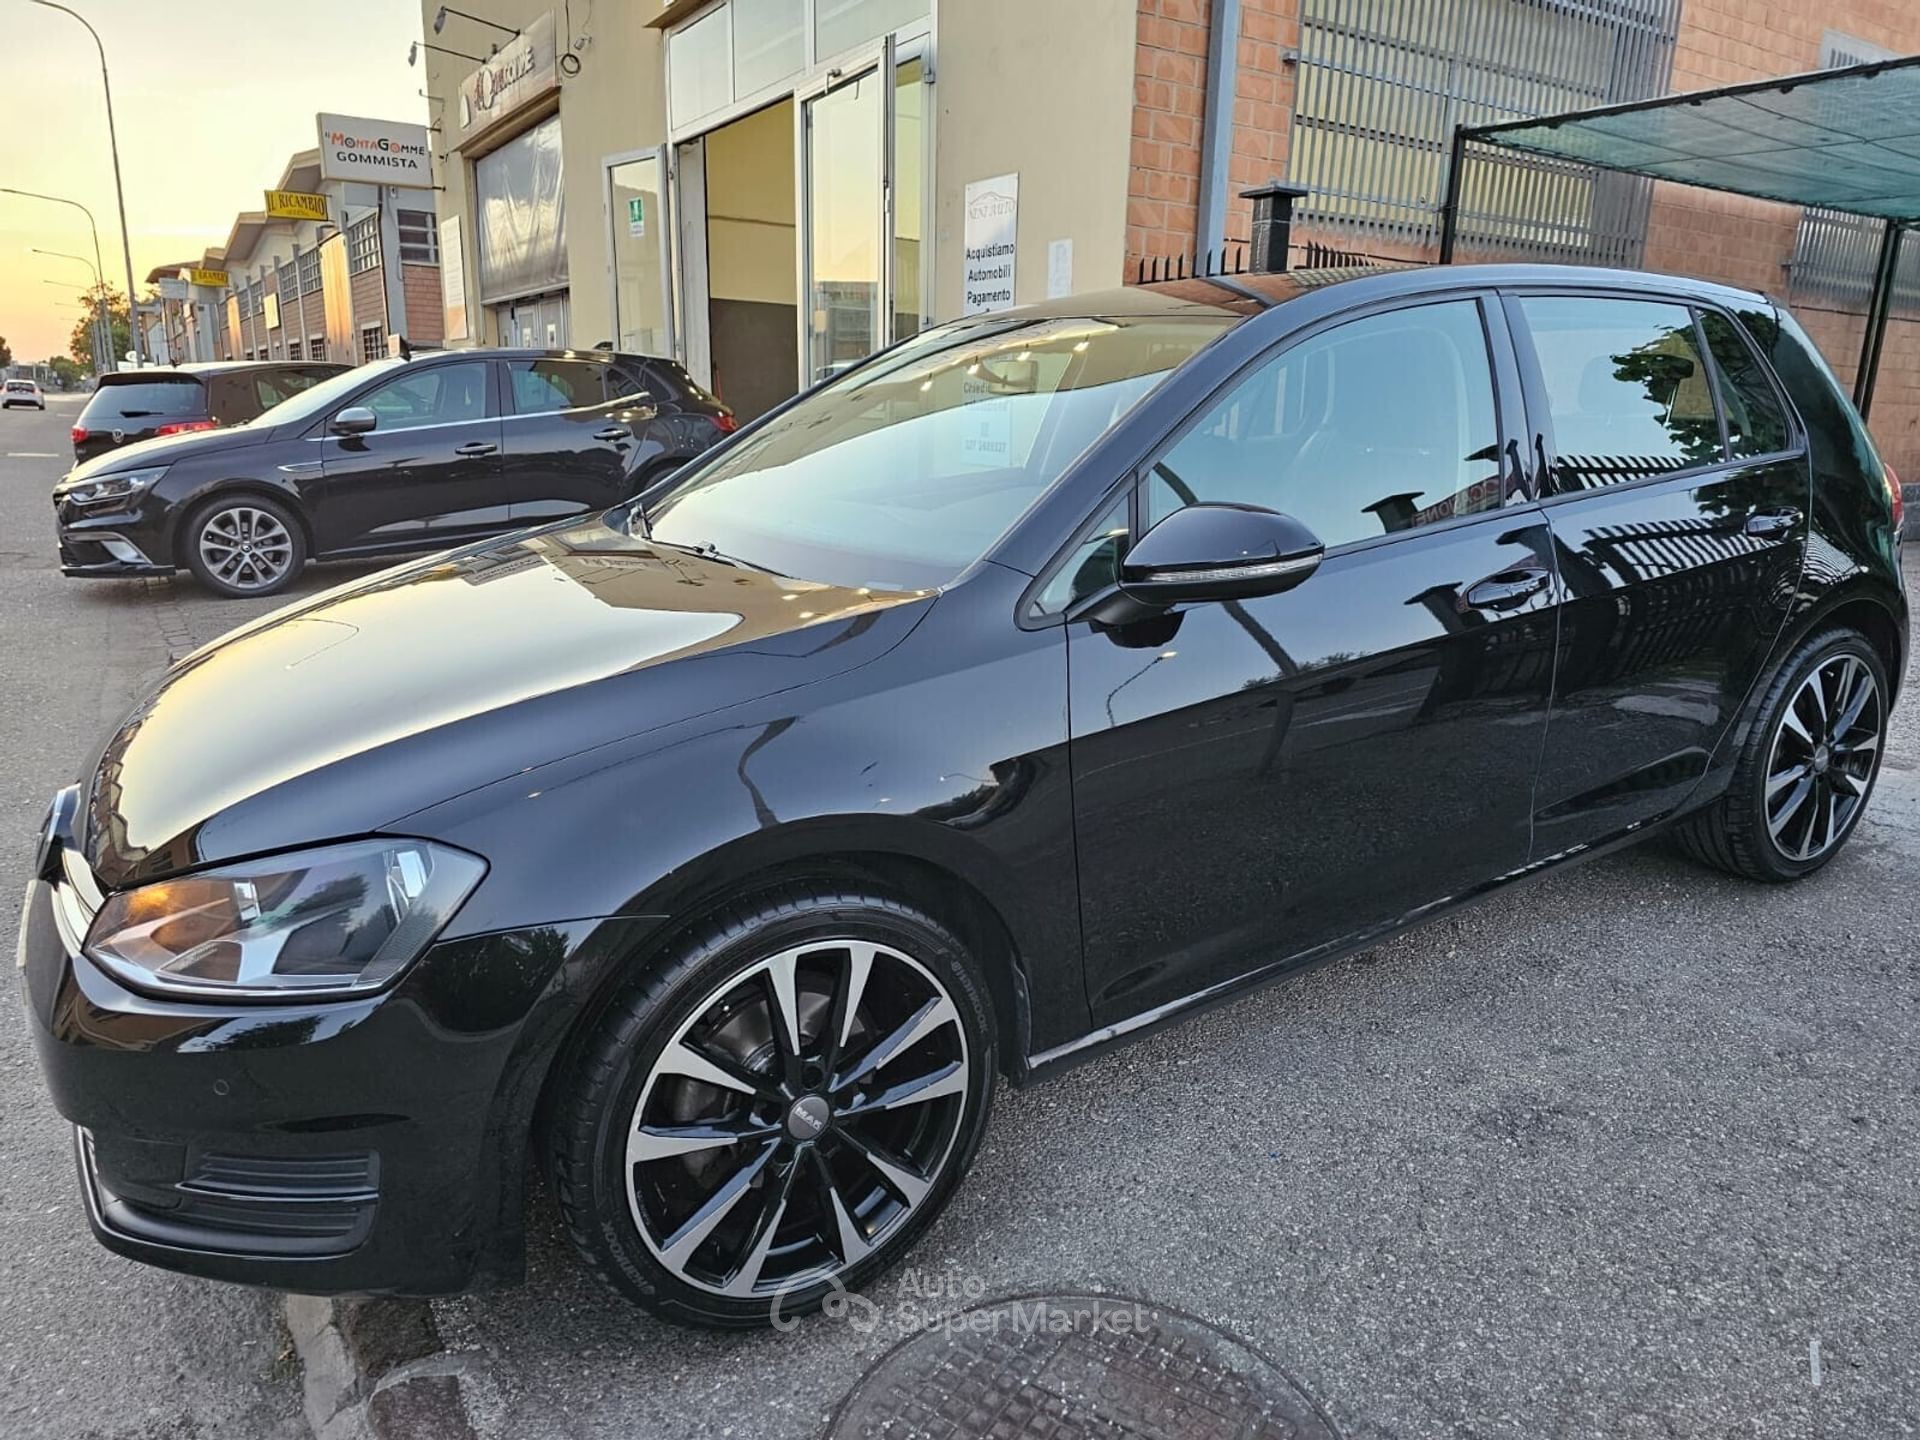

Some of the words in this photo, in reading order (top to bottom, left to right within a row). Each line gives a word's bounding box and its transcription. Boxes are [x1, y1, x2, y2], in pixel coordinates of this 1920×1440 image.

[336, 151, 418, 169] GOMMISTA
[279, 193, 325, 216] RICAMBIO
[966, 243, 1015, 262] Acquistiamo
[968, 264, 1011, 282] Automobili
[967, 288, 1011, 306] Pagamento
